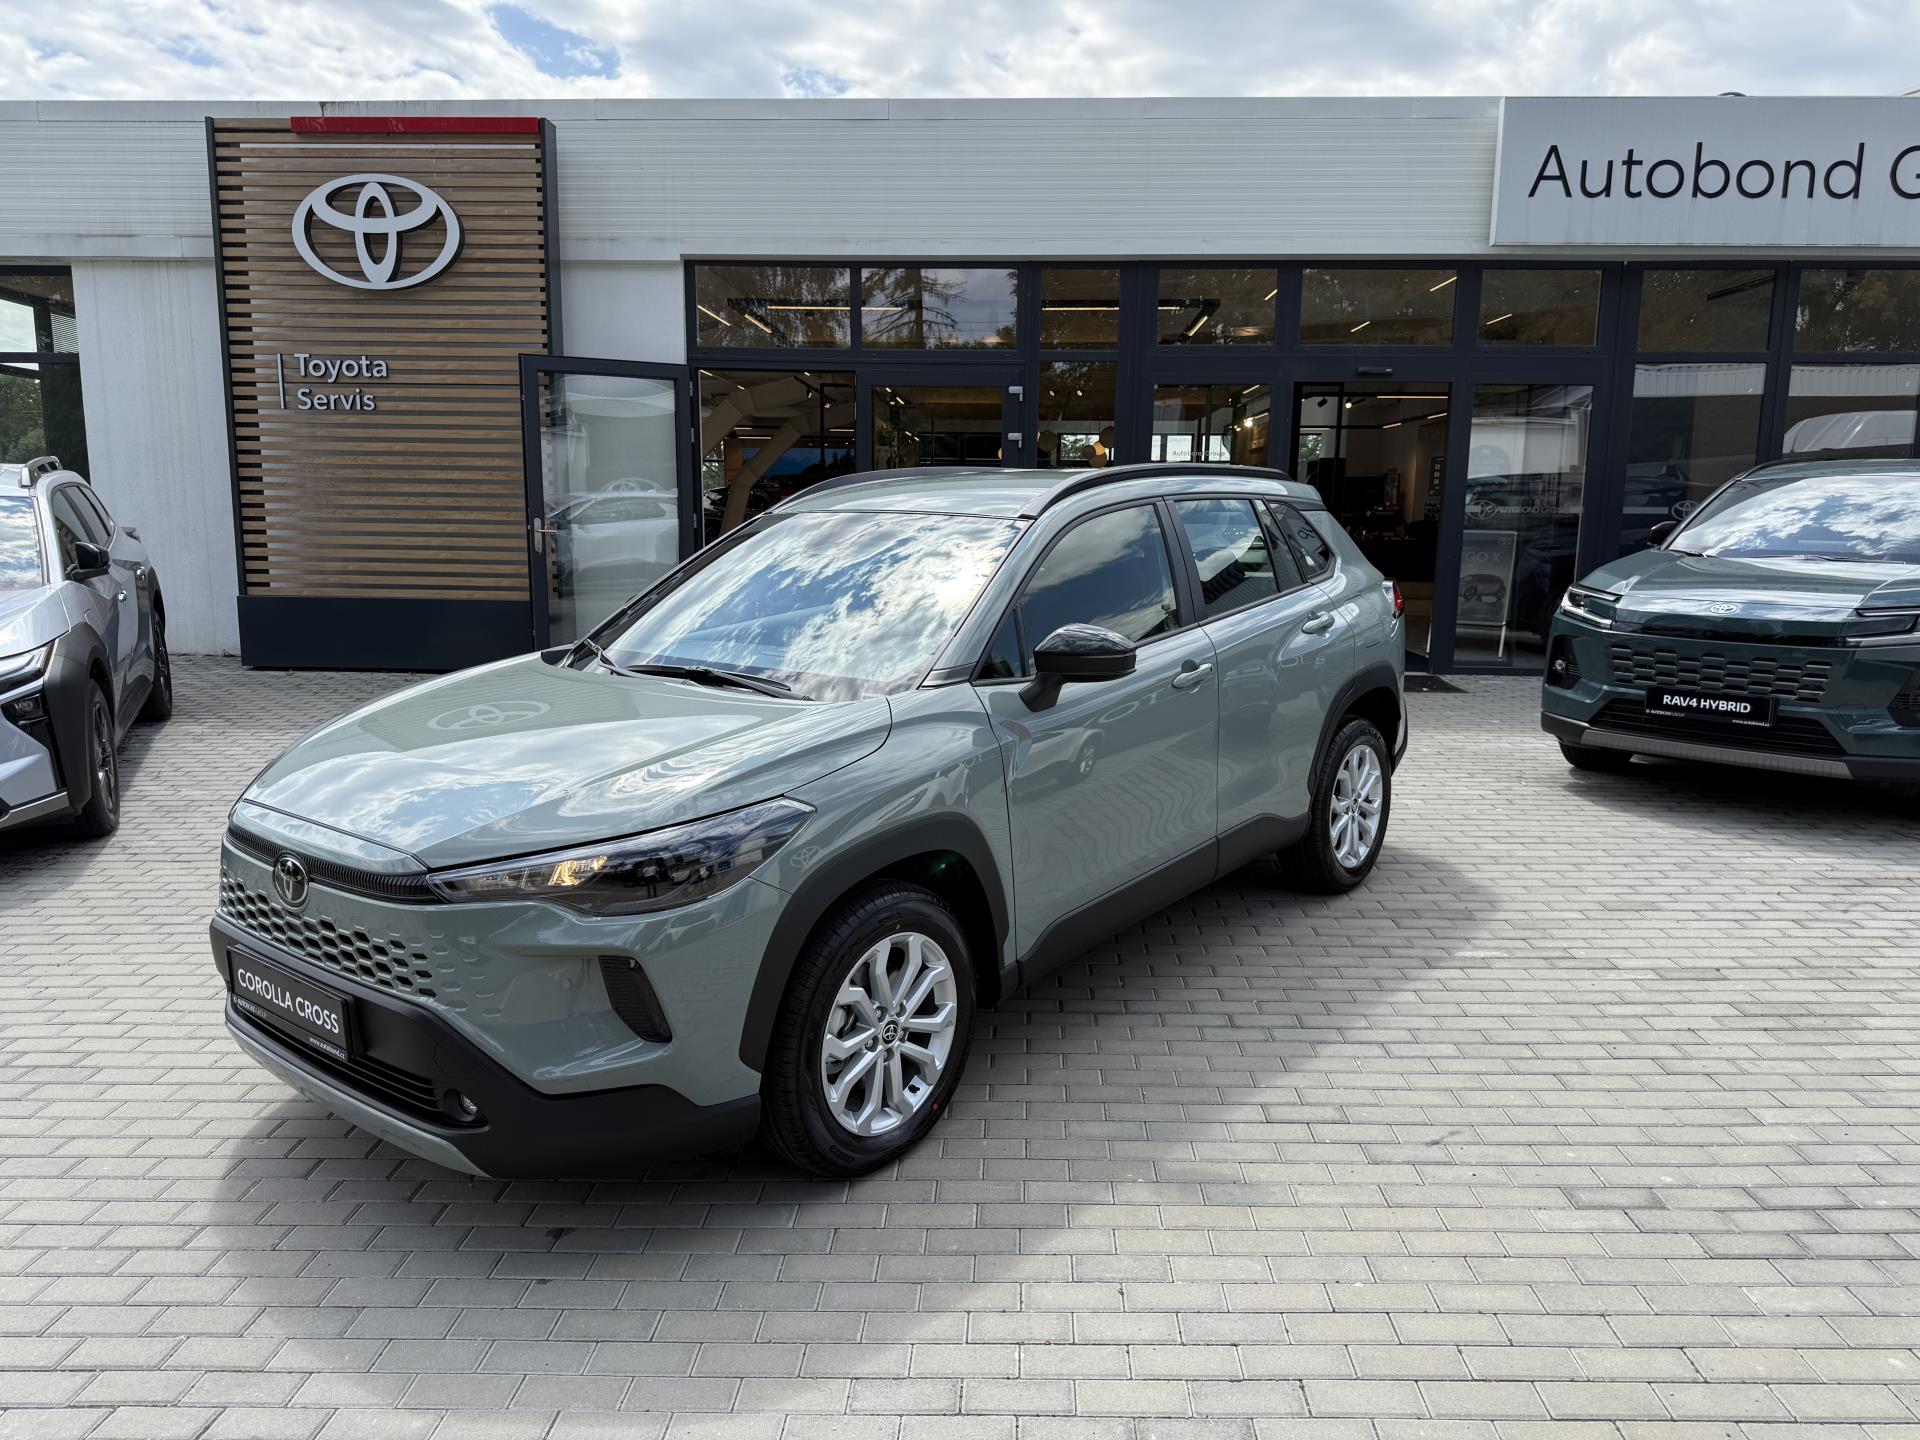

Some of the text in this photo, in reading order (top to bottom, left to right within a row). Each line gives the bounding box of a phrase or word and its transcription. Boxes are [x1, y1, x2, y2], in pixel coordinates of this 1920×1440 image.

[1527, 141, 1866, 200] Autobond
[294, 352, 389, 383] Toyota
[297, 387, 377, 411] Servis
[1662, 694, 1751, 713] RAV4 HYBRID
[237, 968, 339, 1034] COROLLA CROSS
